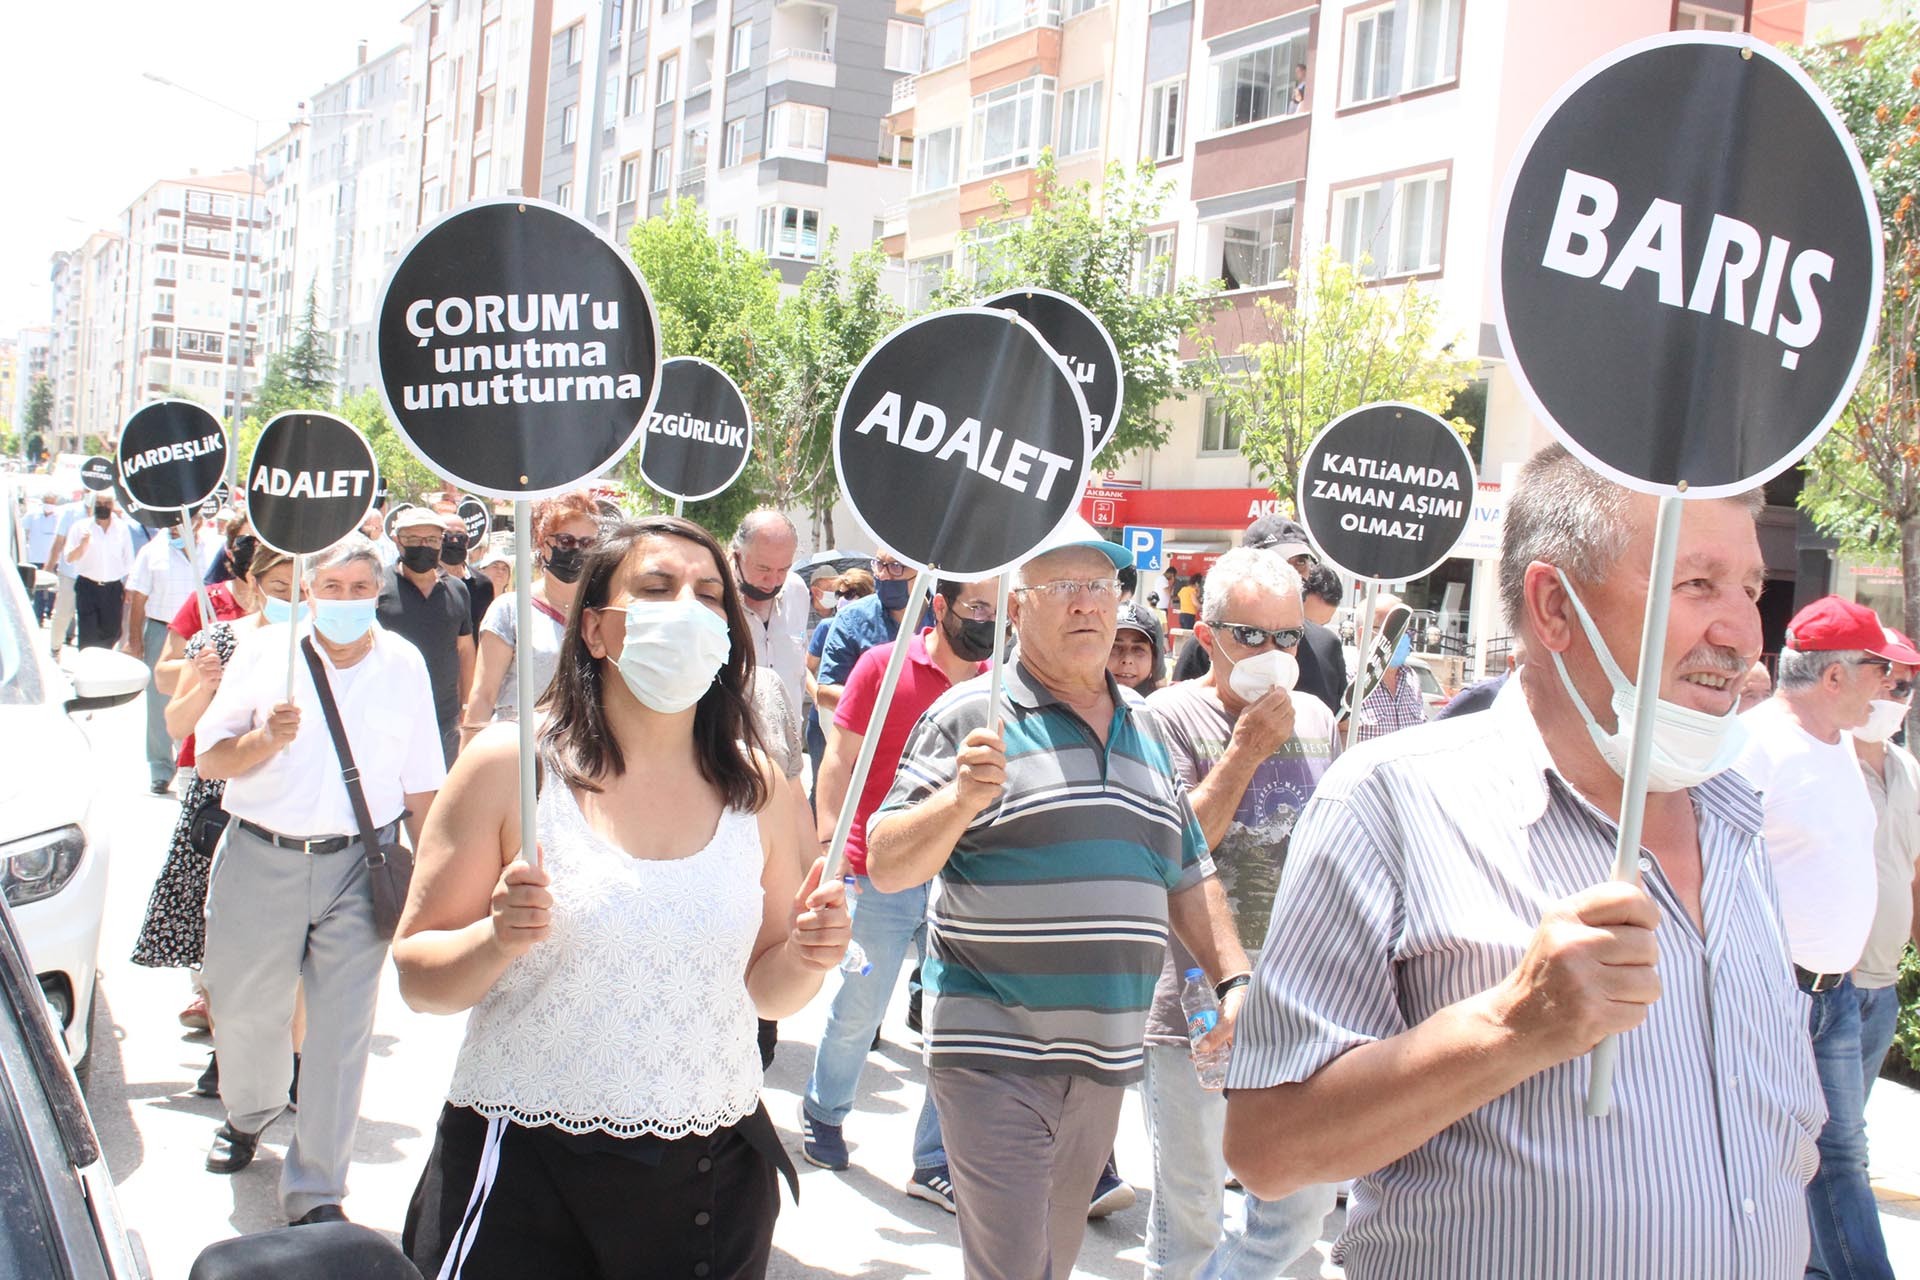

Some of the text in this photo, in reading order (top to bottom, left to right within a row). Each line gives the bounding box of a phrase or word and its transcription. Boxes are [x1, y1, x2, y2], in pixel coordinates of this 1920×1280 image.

[1541, 168, 1835, 371] BARIŞ
[405, 293, 620, 348] ÇORUM'u
[434, 337, 607, 374] unutma
[403, 372, 642, 411] unutturma
[648, 412, 746, 449] ZGÜRLÜK
[854, 390, 1074, 502] ADALET
[251, 464, 370, 499] ADALET
[1086, 489, 1124, 499] AKBANK
[1311, 479, 1463, 519] ZAMAN AŞIMI
[1097, 513, 1108, 522] 24
[1340, 513, 1425, 542] OLMAZ!
[1131, 530, 1155, 561] P
[1274, 742, 1331, 754] VEREST
